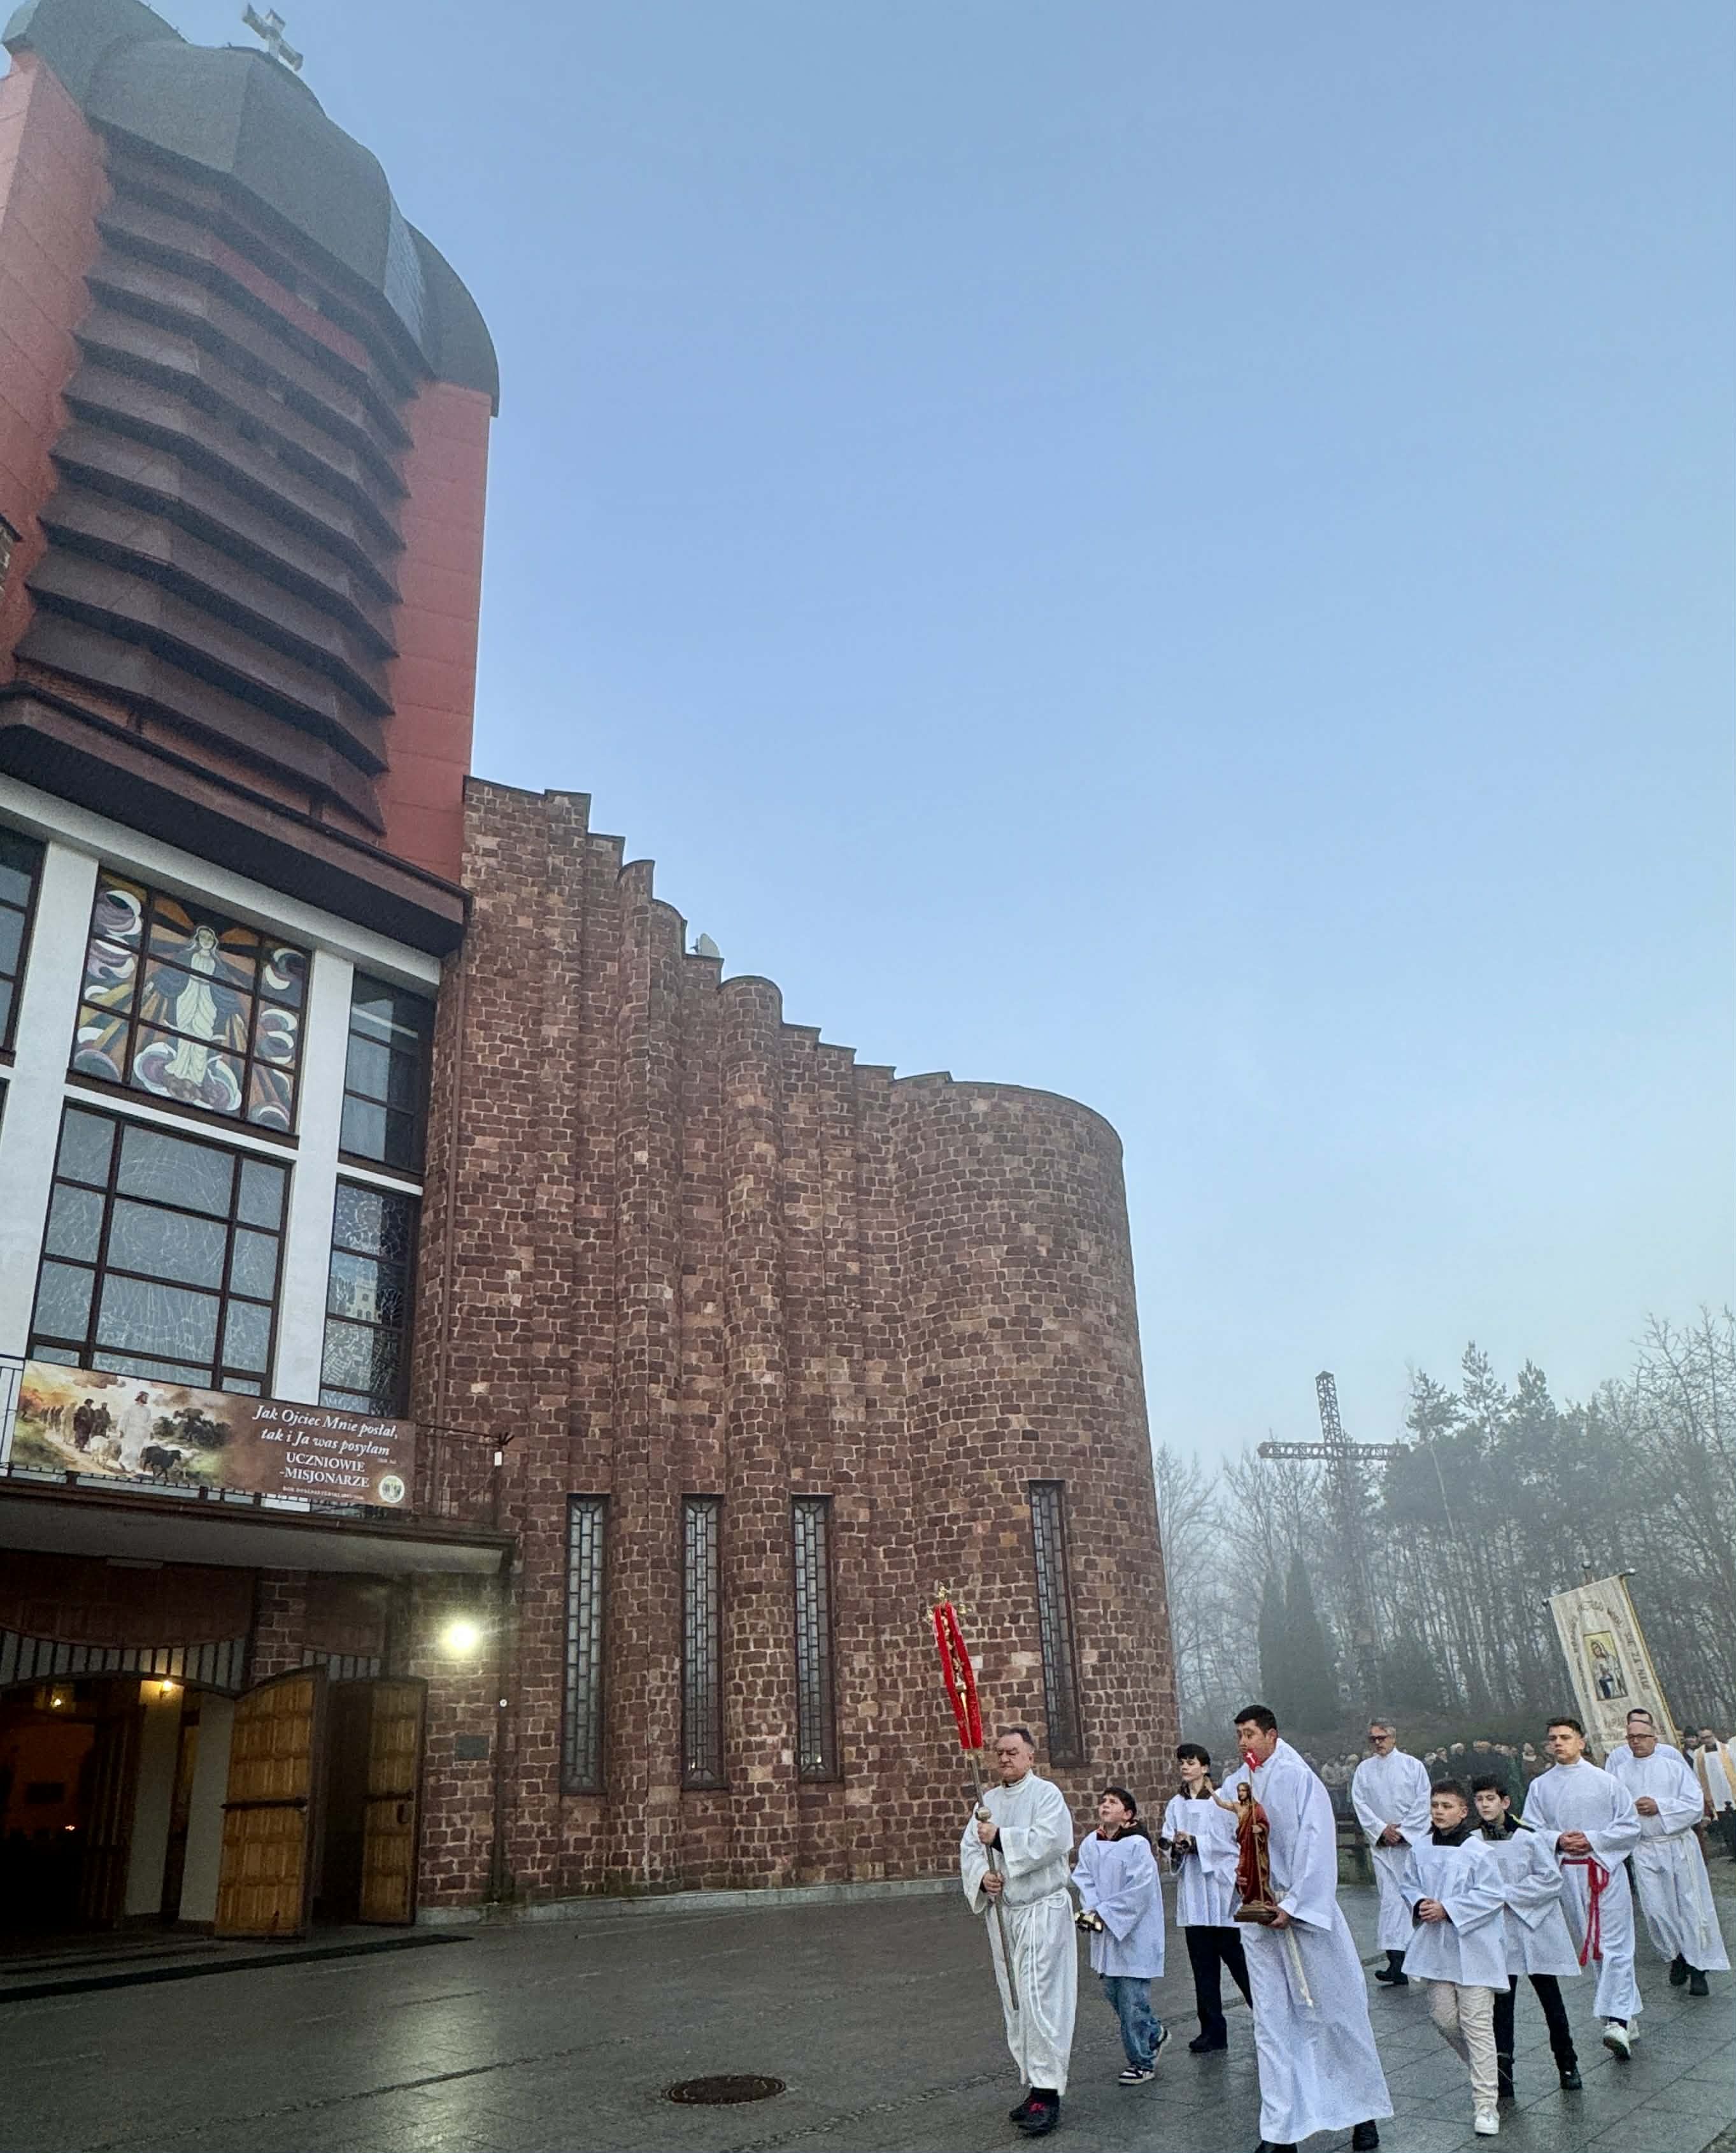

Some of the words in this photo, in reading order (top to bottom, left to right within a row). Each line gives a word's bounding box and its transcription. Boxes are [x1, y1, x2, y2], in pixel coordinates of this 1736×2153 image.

[252, 1405, 278, 1420] Jak
[281, 1410, 321, 1426] Ojciec
[322, 1415, 357, 1432] Mnie
[357, 1423, 398, 1440] posłał,
[261, 1428, 283, 1441] tak
[287, 1431, 292, 1443] i
[292, 1431, 309, 1447] Ja
[313, 1438, 338, 1449] was
[339, 1440, 390, 1457] posyłam
[287, 1452, 366, 1472] UCZNIOWIE
[280, 1466, 370, 1488] -MISJONARZE
